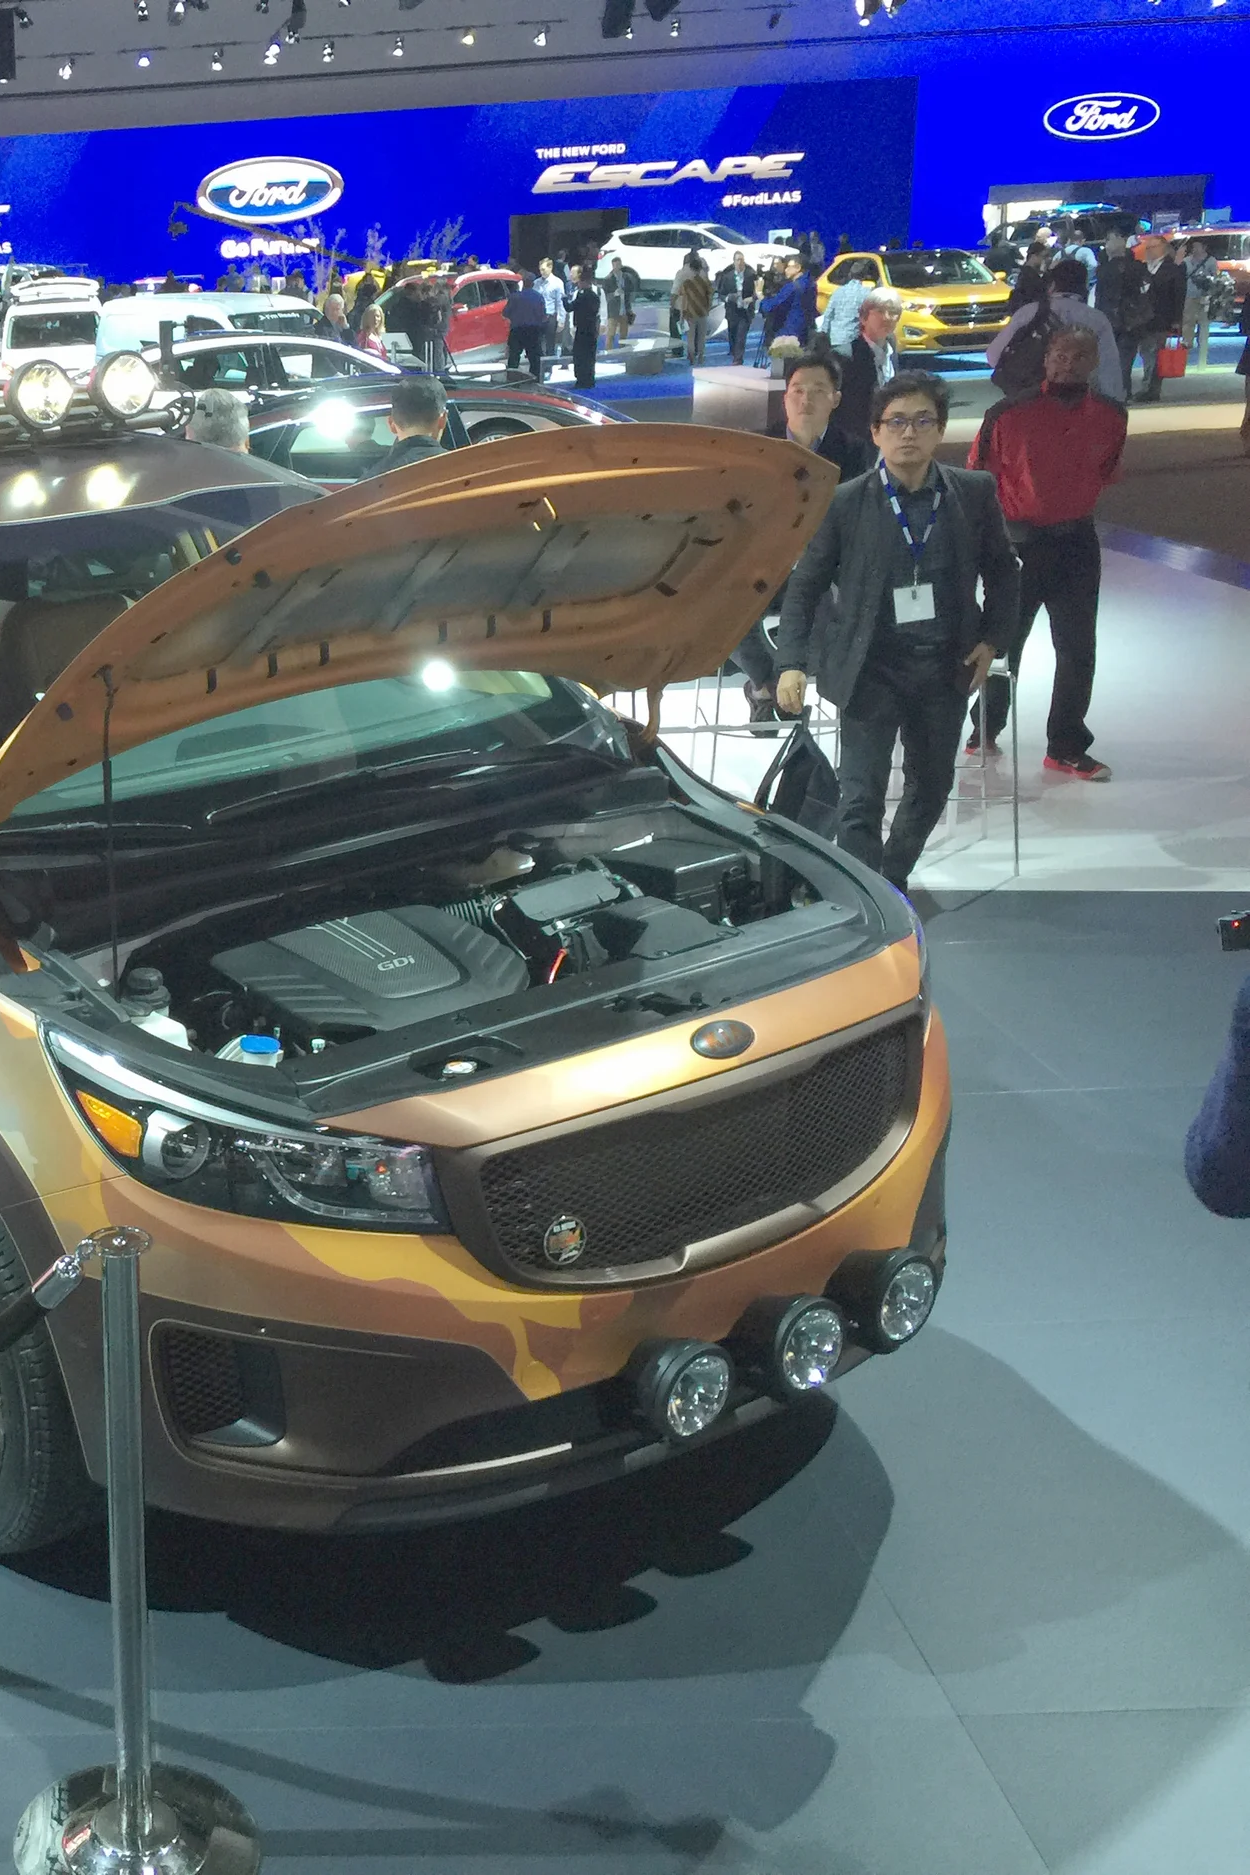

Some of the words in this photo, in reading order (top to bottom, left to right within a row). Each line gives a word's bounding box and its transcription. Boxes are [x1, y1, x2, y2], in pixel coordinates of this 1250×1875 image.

[1065, 100, 1139, 132] Ford
[535, 148, 560, 159] THE
[562, 146, 591, 157] NEW
[592, 143, 626, 155] FORD
[531, 152, 805, 194] ESCAPE
[228, 175, 310, 208] Ford
[721, 190, 802, 207] #FordLAAS
[220, 239, 251, 259] Go
[377, 955, 416, 972] GDi
